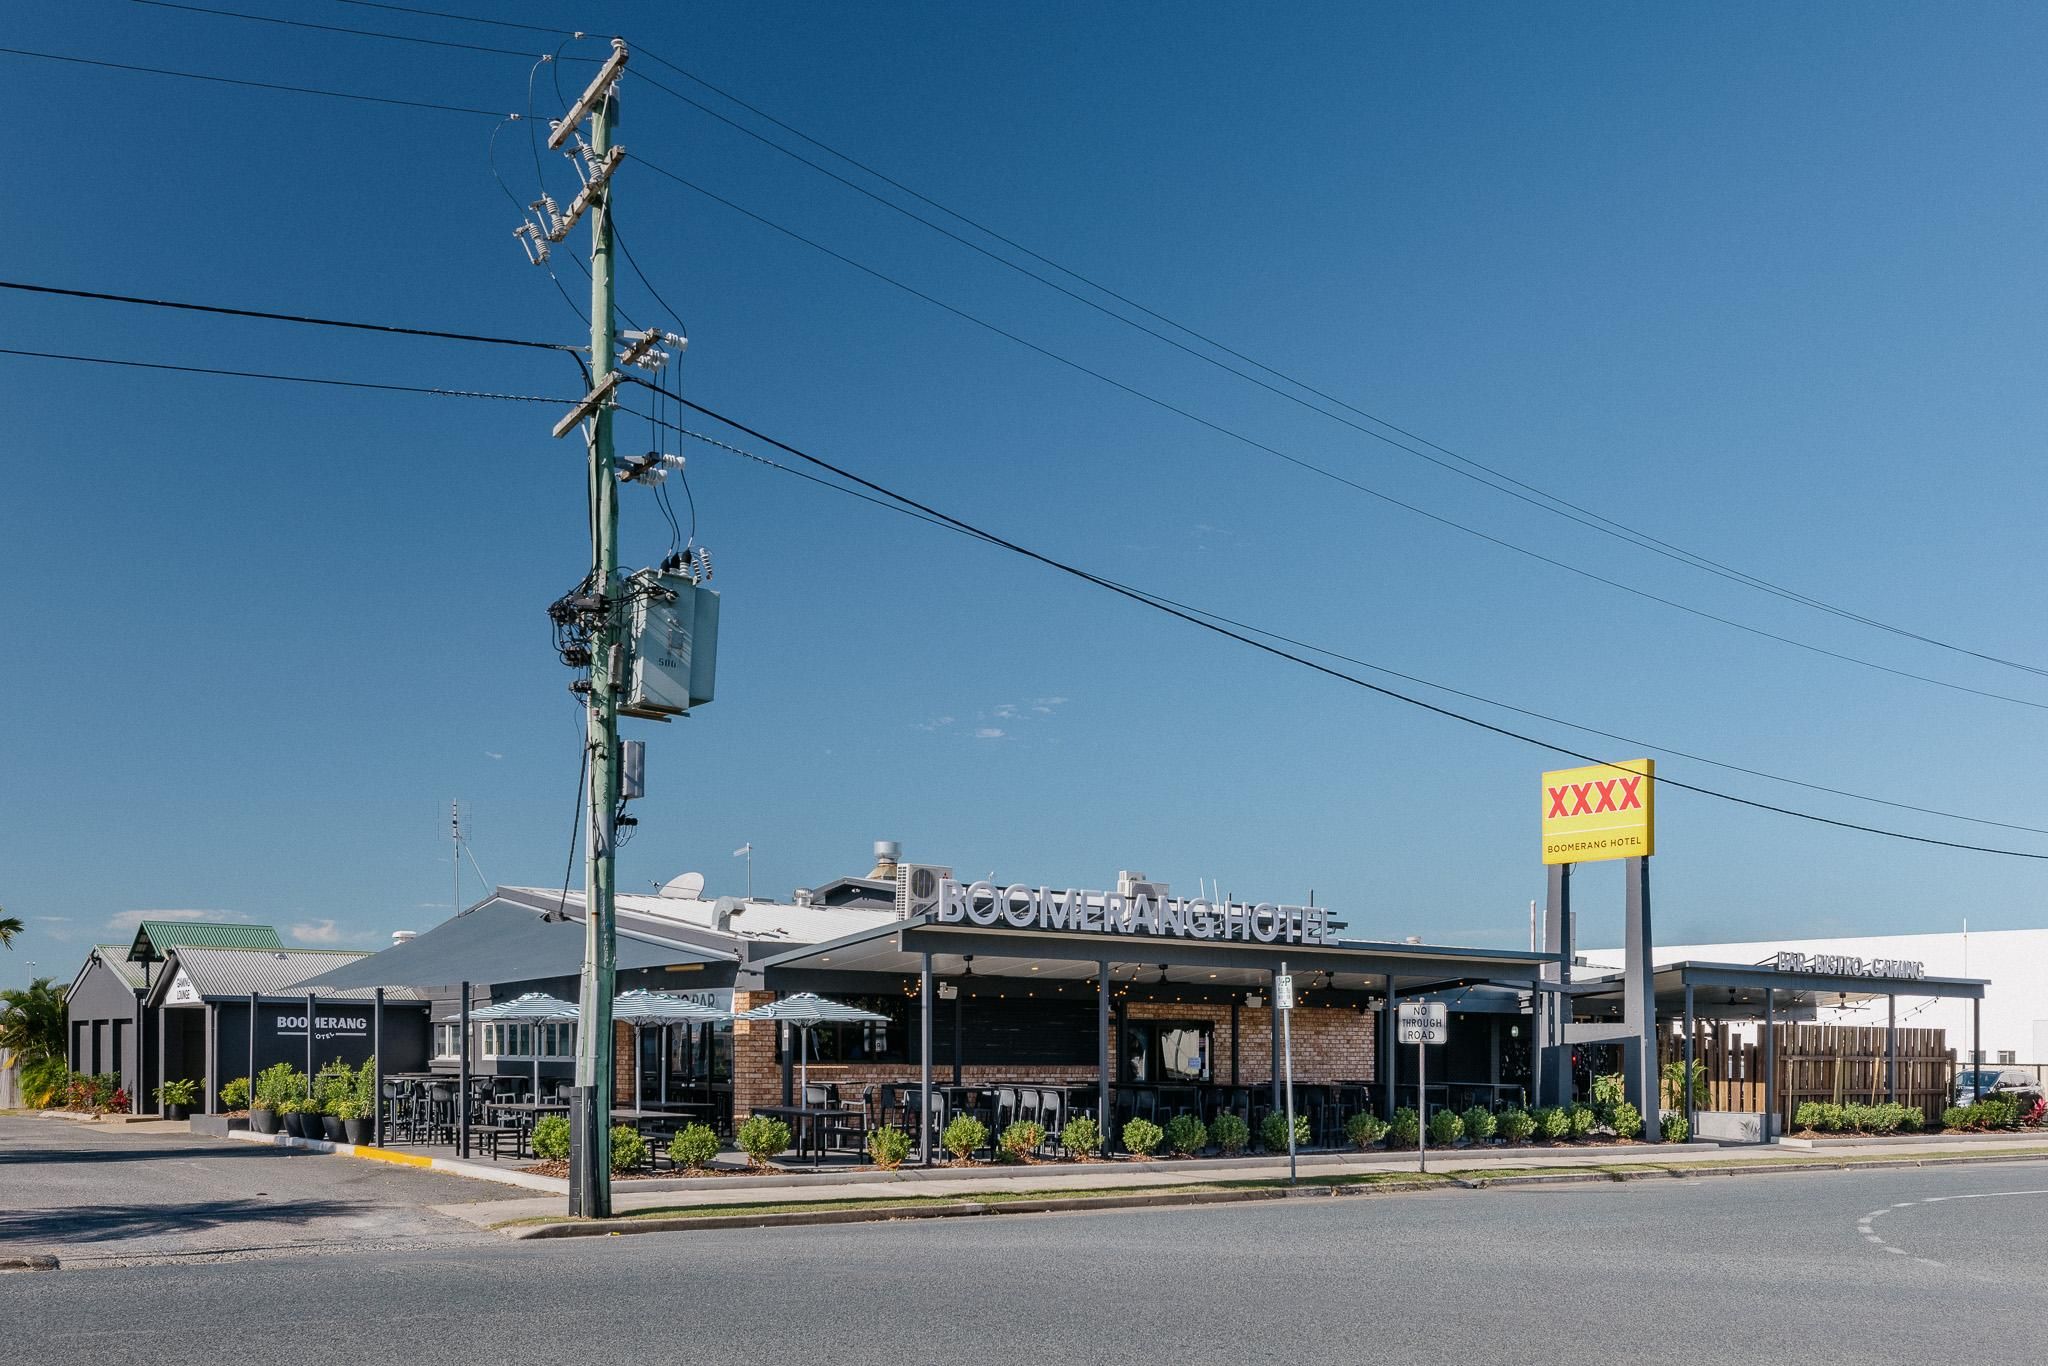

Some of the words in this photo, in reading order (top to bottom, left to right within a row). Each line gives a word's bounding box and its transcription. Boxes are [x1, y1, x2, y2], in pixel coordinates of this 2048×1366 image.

[1548, 776, 1642, 819] XXXX
[1547, 840, 1607, 854] BOOMERANG
[1610, 836, 1641, 847] HOTEL
[938, 878, 1215, 939] BOOMERANG
[1225, 900, 1340, 946] HOTEL
[1870, 958, 1925, 980] GAMING
[1413, 1006, 1428, 1016] NO
[1402, 1018, 1443, 1028] THROUGH
[315, 1032, 335, 1040] OTEL
[1407, 1030, 1436, 1040] ROAD
